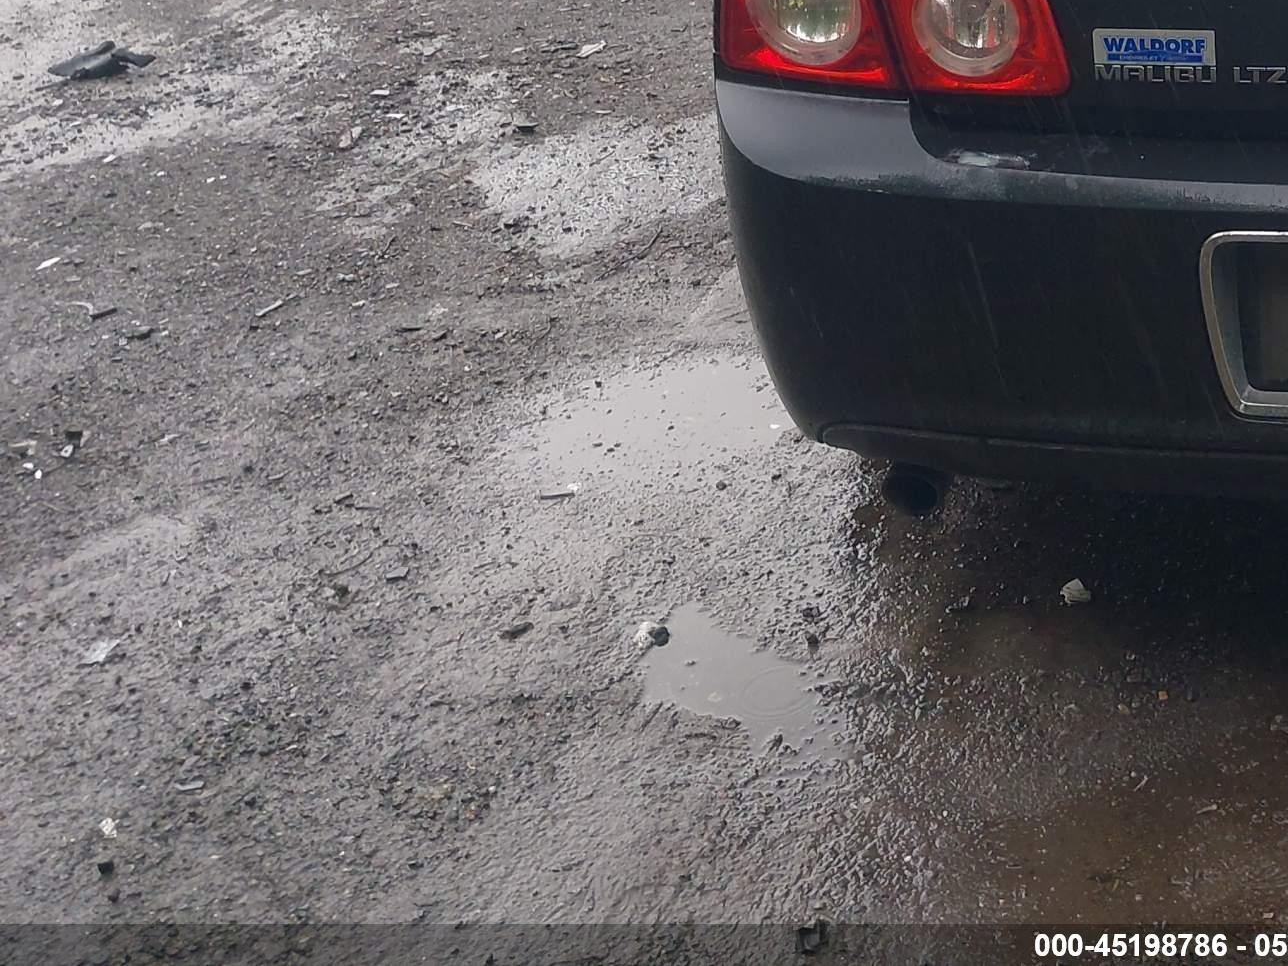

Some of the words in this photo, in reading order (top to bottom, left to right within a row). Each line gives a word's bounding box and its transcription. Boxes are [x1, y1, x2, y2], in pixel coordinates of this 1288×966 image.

[1103, 37, 1206, 53] WALDORF
[1094, 64, 1217, 83] MALIBU
[1233, 66, 1287, 83] LTZ
